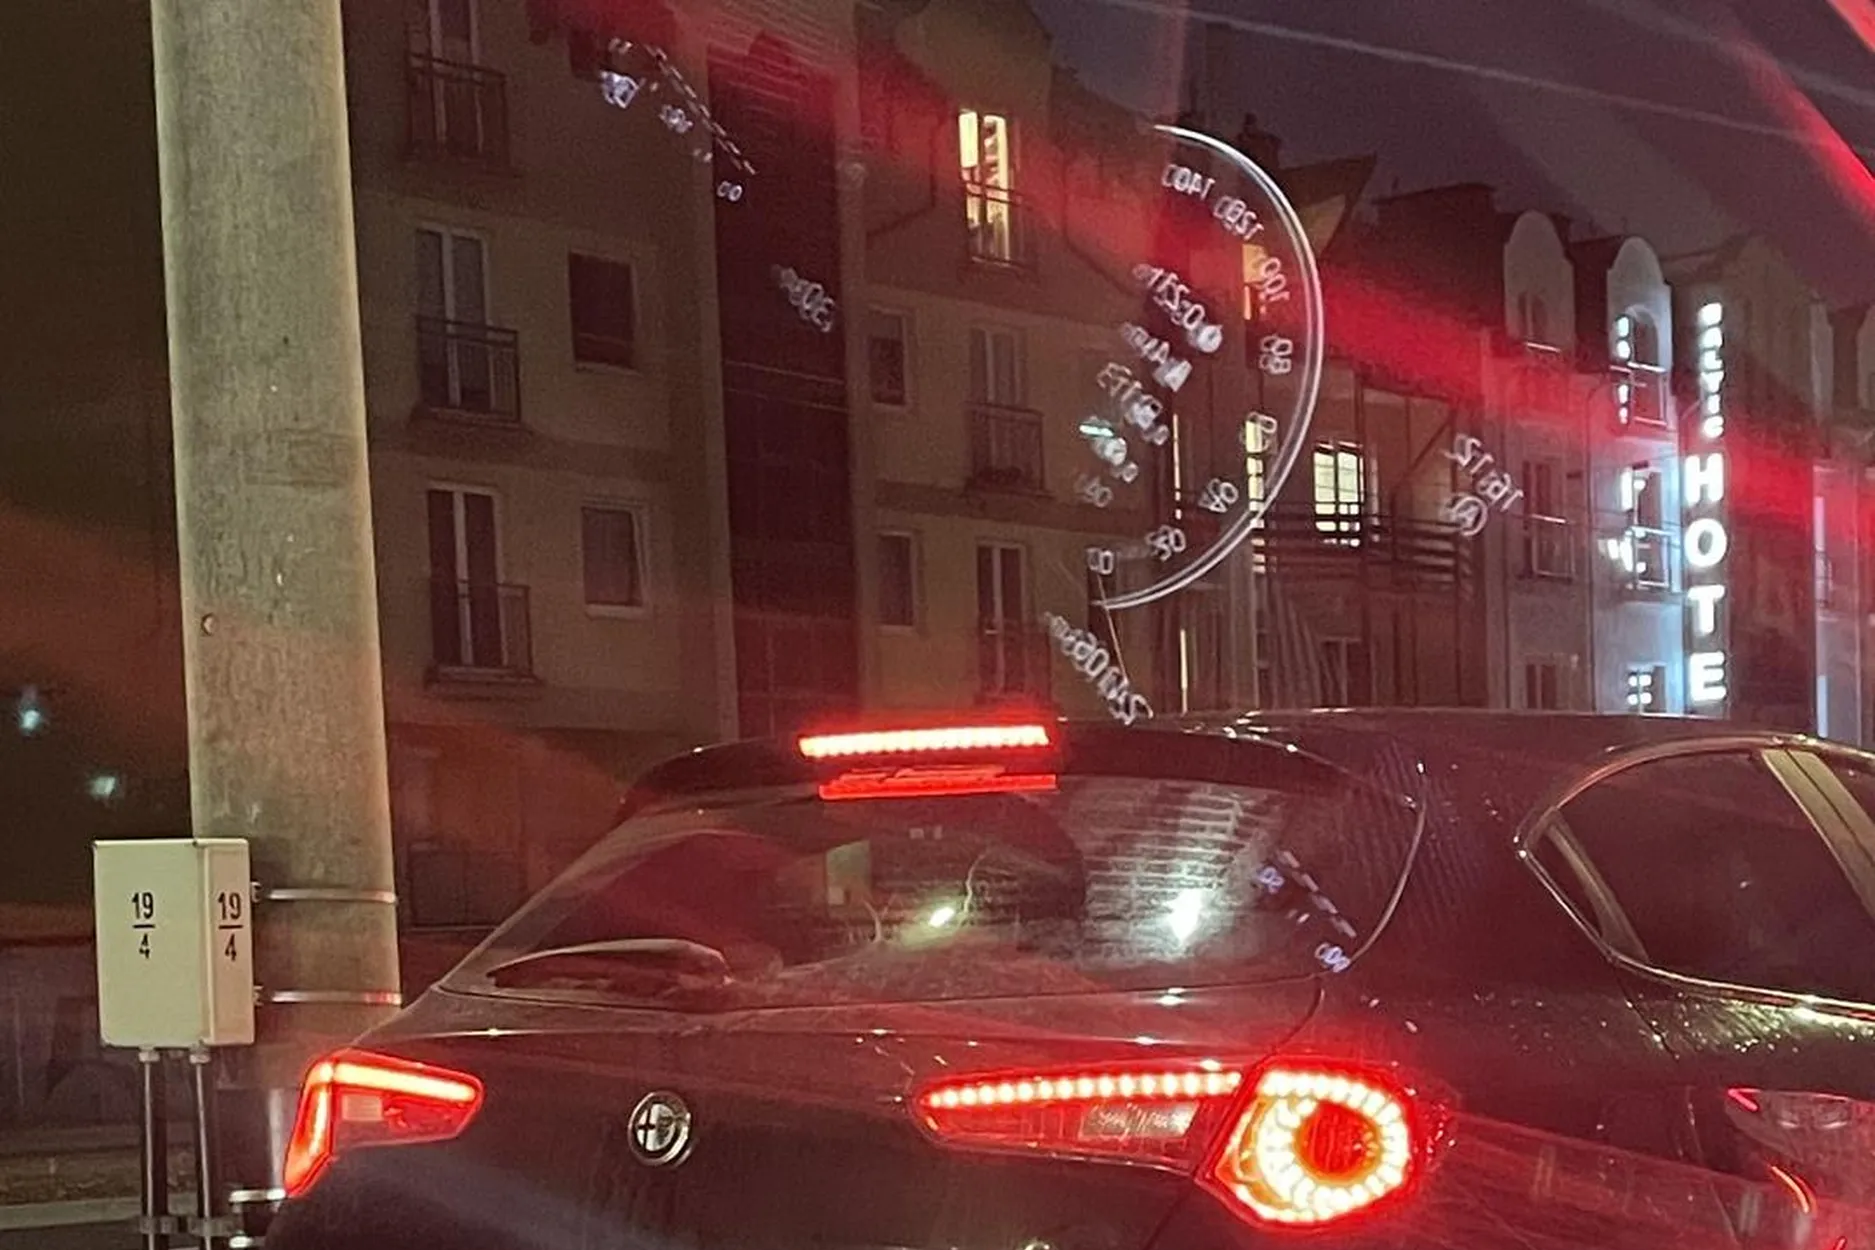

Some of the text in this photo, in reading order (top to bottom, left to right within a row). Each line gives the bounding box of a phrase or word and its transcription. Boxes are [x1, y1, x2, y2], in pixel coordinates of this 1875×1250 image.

[1684, 452, 1728, 702] HOTE
[131, 892, 154, 919] 19
[218, 892, 242, 920] 19
[139, 933, 151, 960] 4
[224, 933, 237, 961] 4
